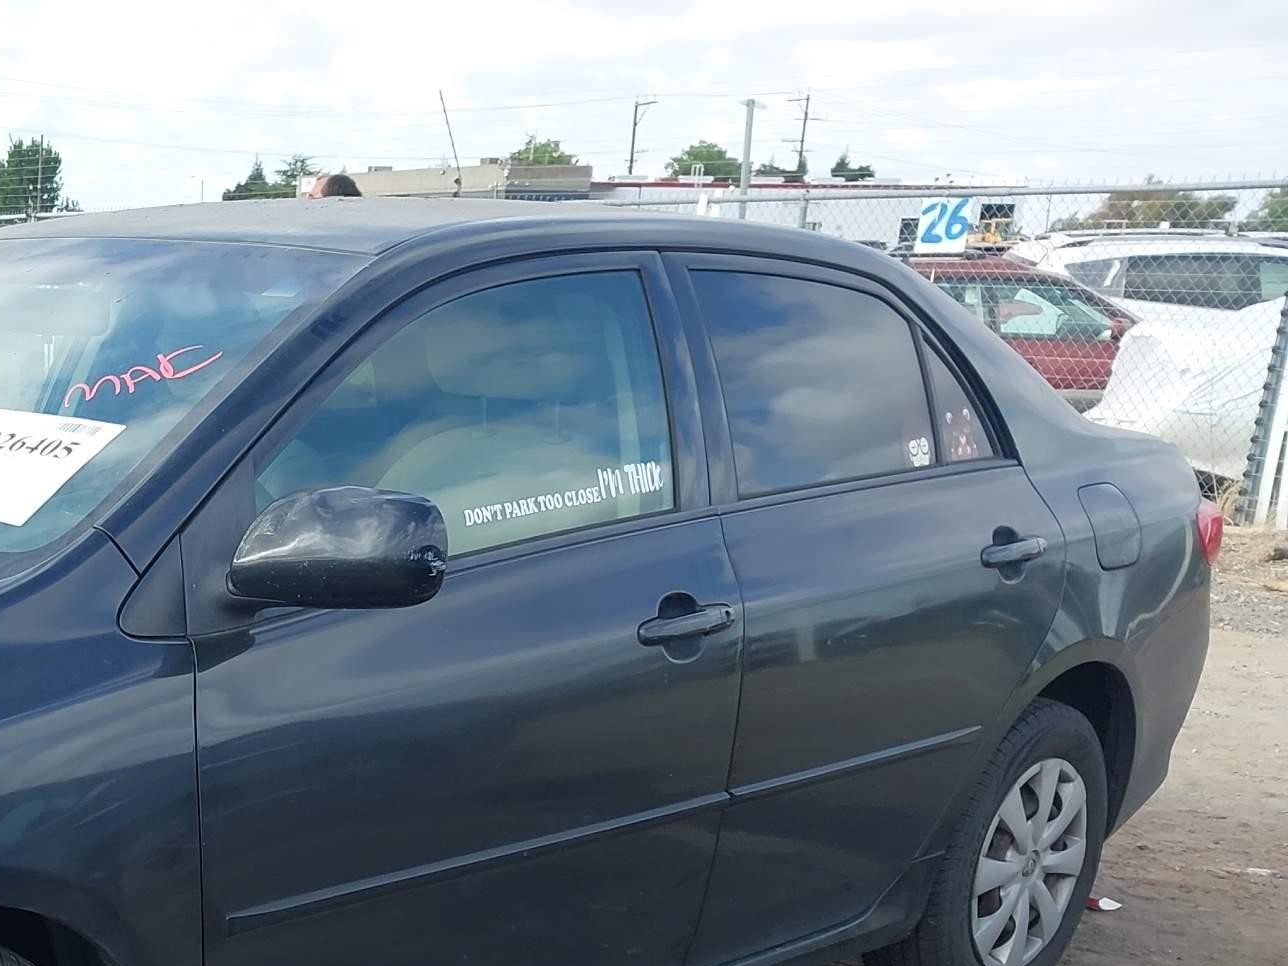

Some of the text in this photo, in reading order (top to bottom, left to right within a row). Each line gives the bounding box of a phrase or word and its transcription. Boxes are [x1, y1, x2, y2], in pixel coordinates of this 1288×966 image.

[920, 196, 969, 243] 26
[463, 505, 503, 527] DON'T
[505, 498, 539, 519] PARK
[538, 494, 563, 512] TOO
[564, 486, 602, 507] CLOSE
